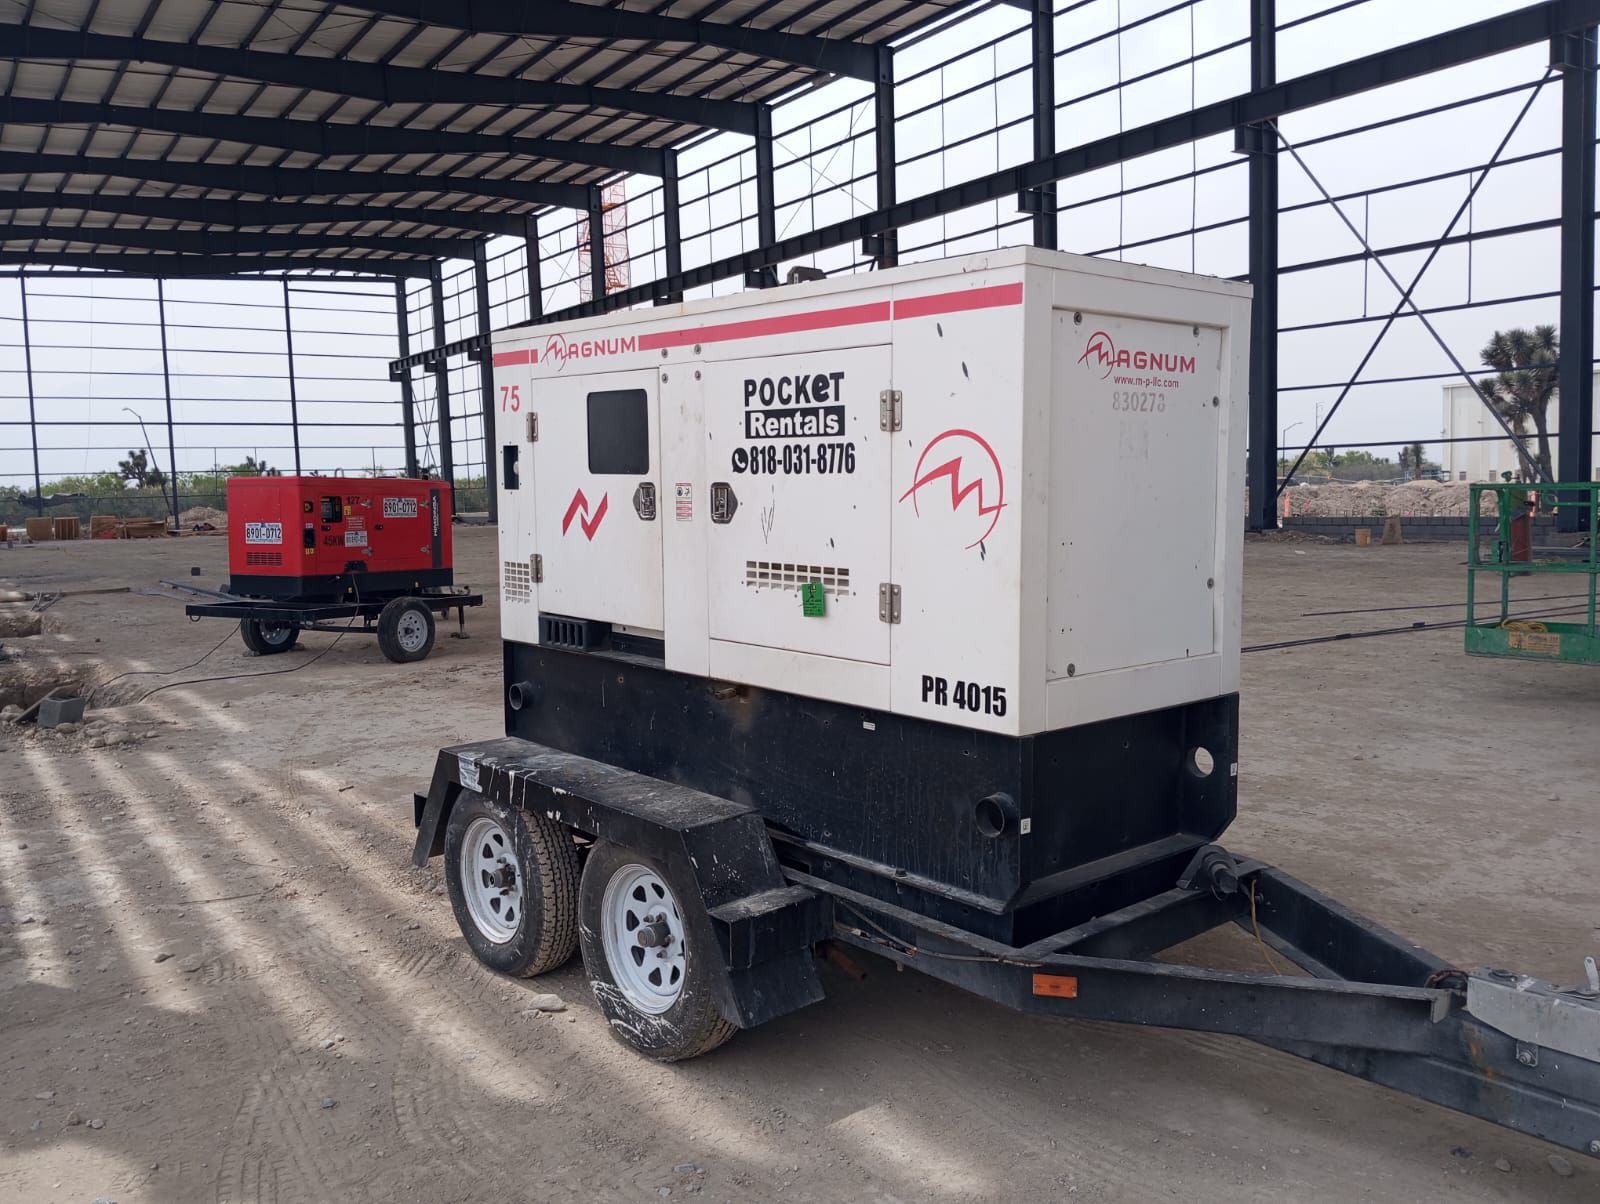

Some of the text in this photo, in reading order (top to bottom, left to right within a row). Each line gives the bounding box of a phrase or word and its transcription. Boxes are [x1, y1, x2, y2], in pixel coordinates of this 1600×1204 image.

[1113, 376, 1179, 389] www.m-p-llc.com
[500, 385, 520, 412] 75
[750, 409, 840, 437] Rentals
[750, 442, 856, 475] 818-031-8776
[922, 675, 1007, 717] PR 4015
